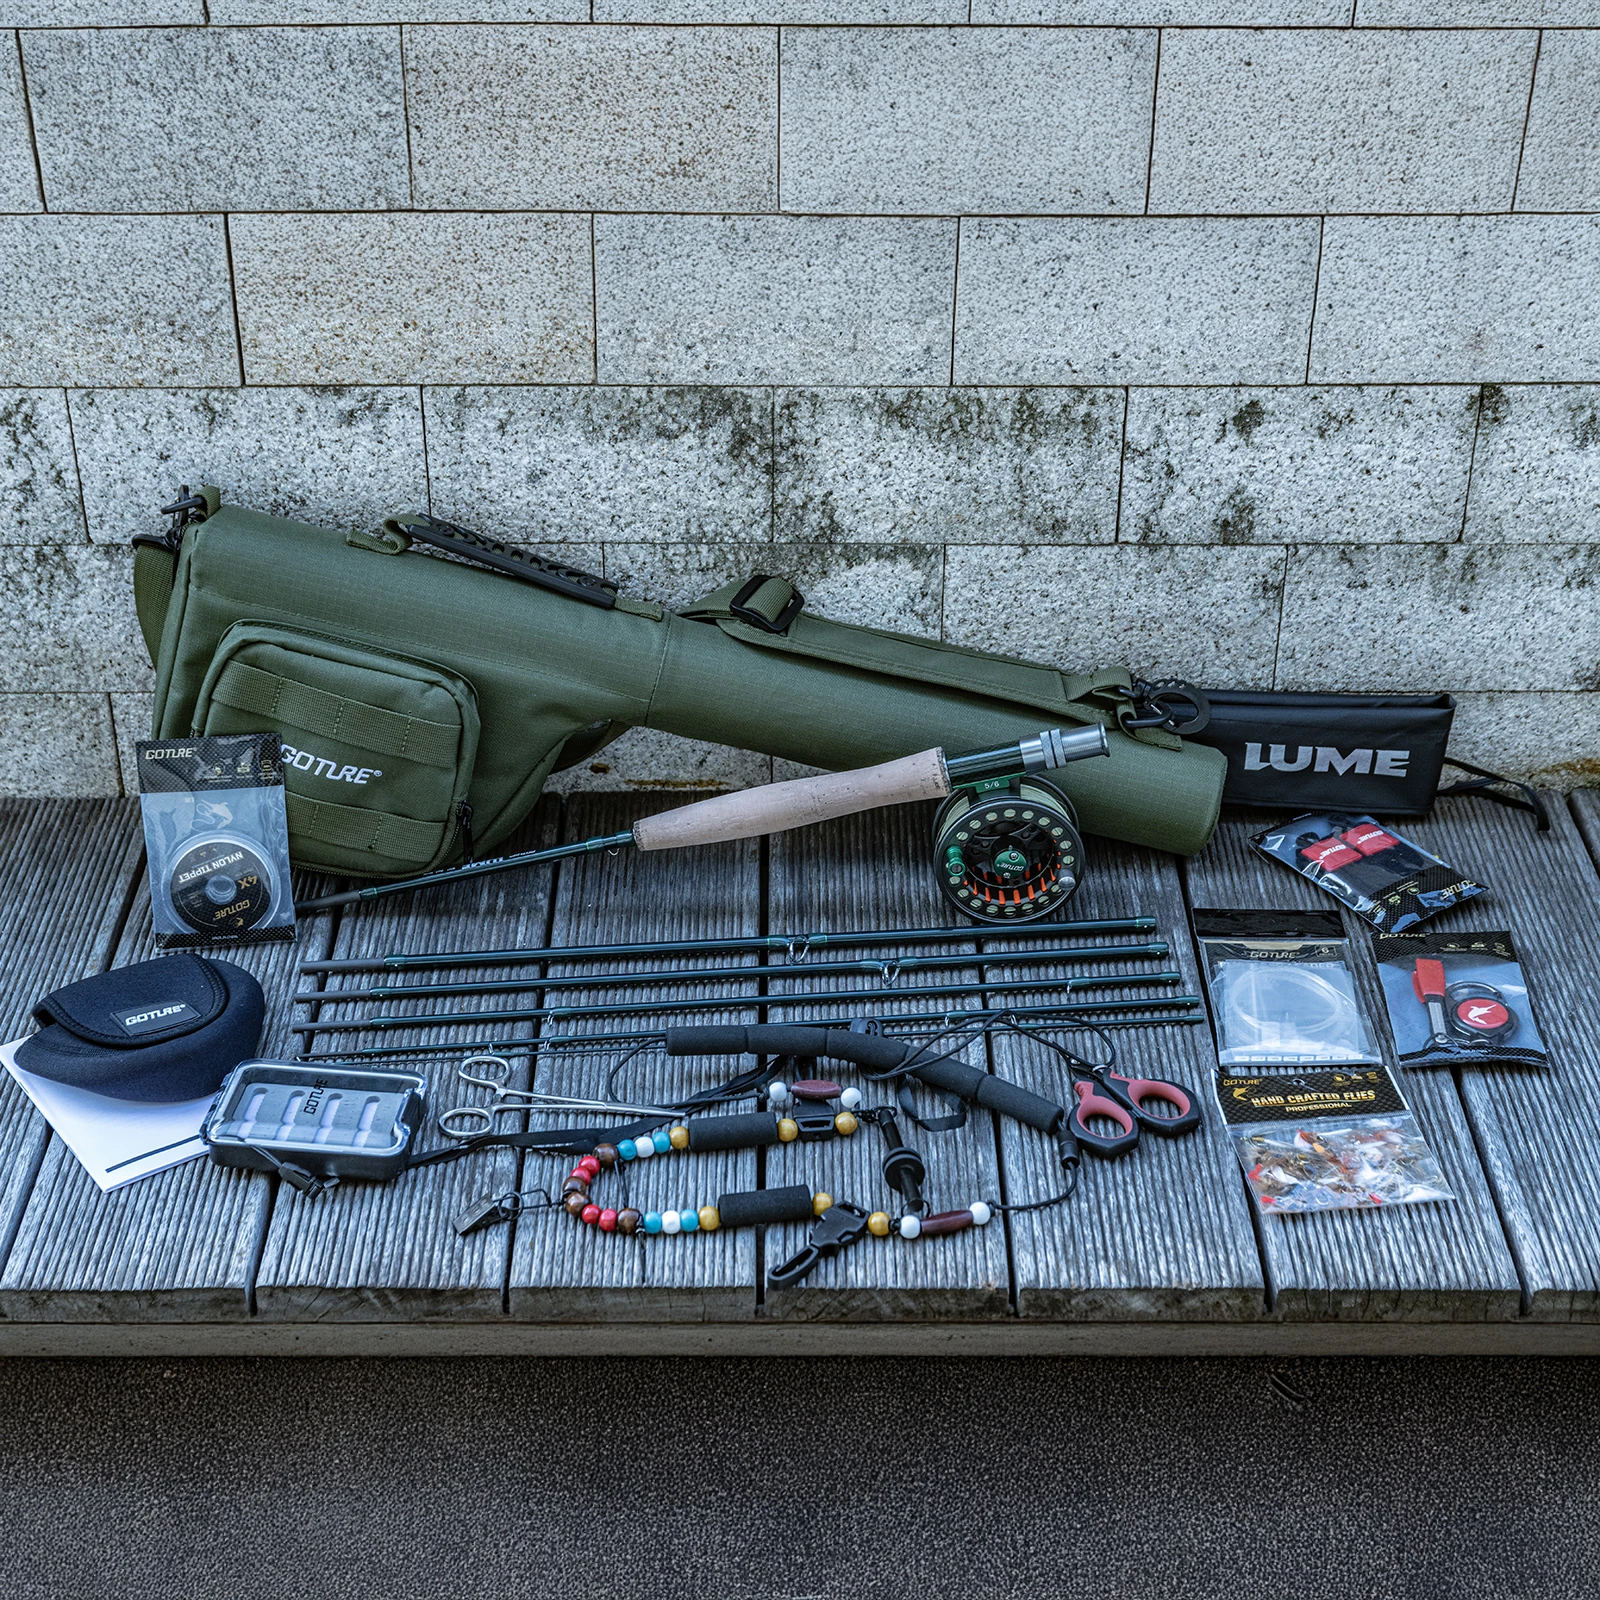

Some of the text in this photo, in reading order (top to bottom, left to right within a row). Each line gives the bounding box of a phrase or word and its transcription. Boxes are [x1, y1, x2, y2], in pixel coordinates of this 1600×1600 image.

[1243, 742, 1410, 778] LUME
[984, 781, 1000, 789] 5/6
[212, 851, 244, 870] NYLON
[178, 863, 213, 884] TIPPET
[237, 875, 258, 890] 4X
[303, 1078, 328, 1115] GOTURE
[1251, 1090, 1376, 1107] HAND CRAFTED FLIES
[1285, 1101, 1352, 1112] PROFESSIONAL
